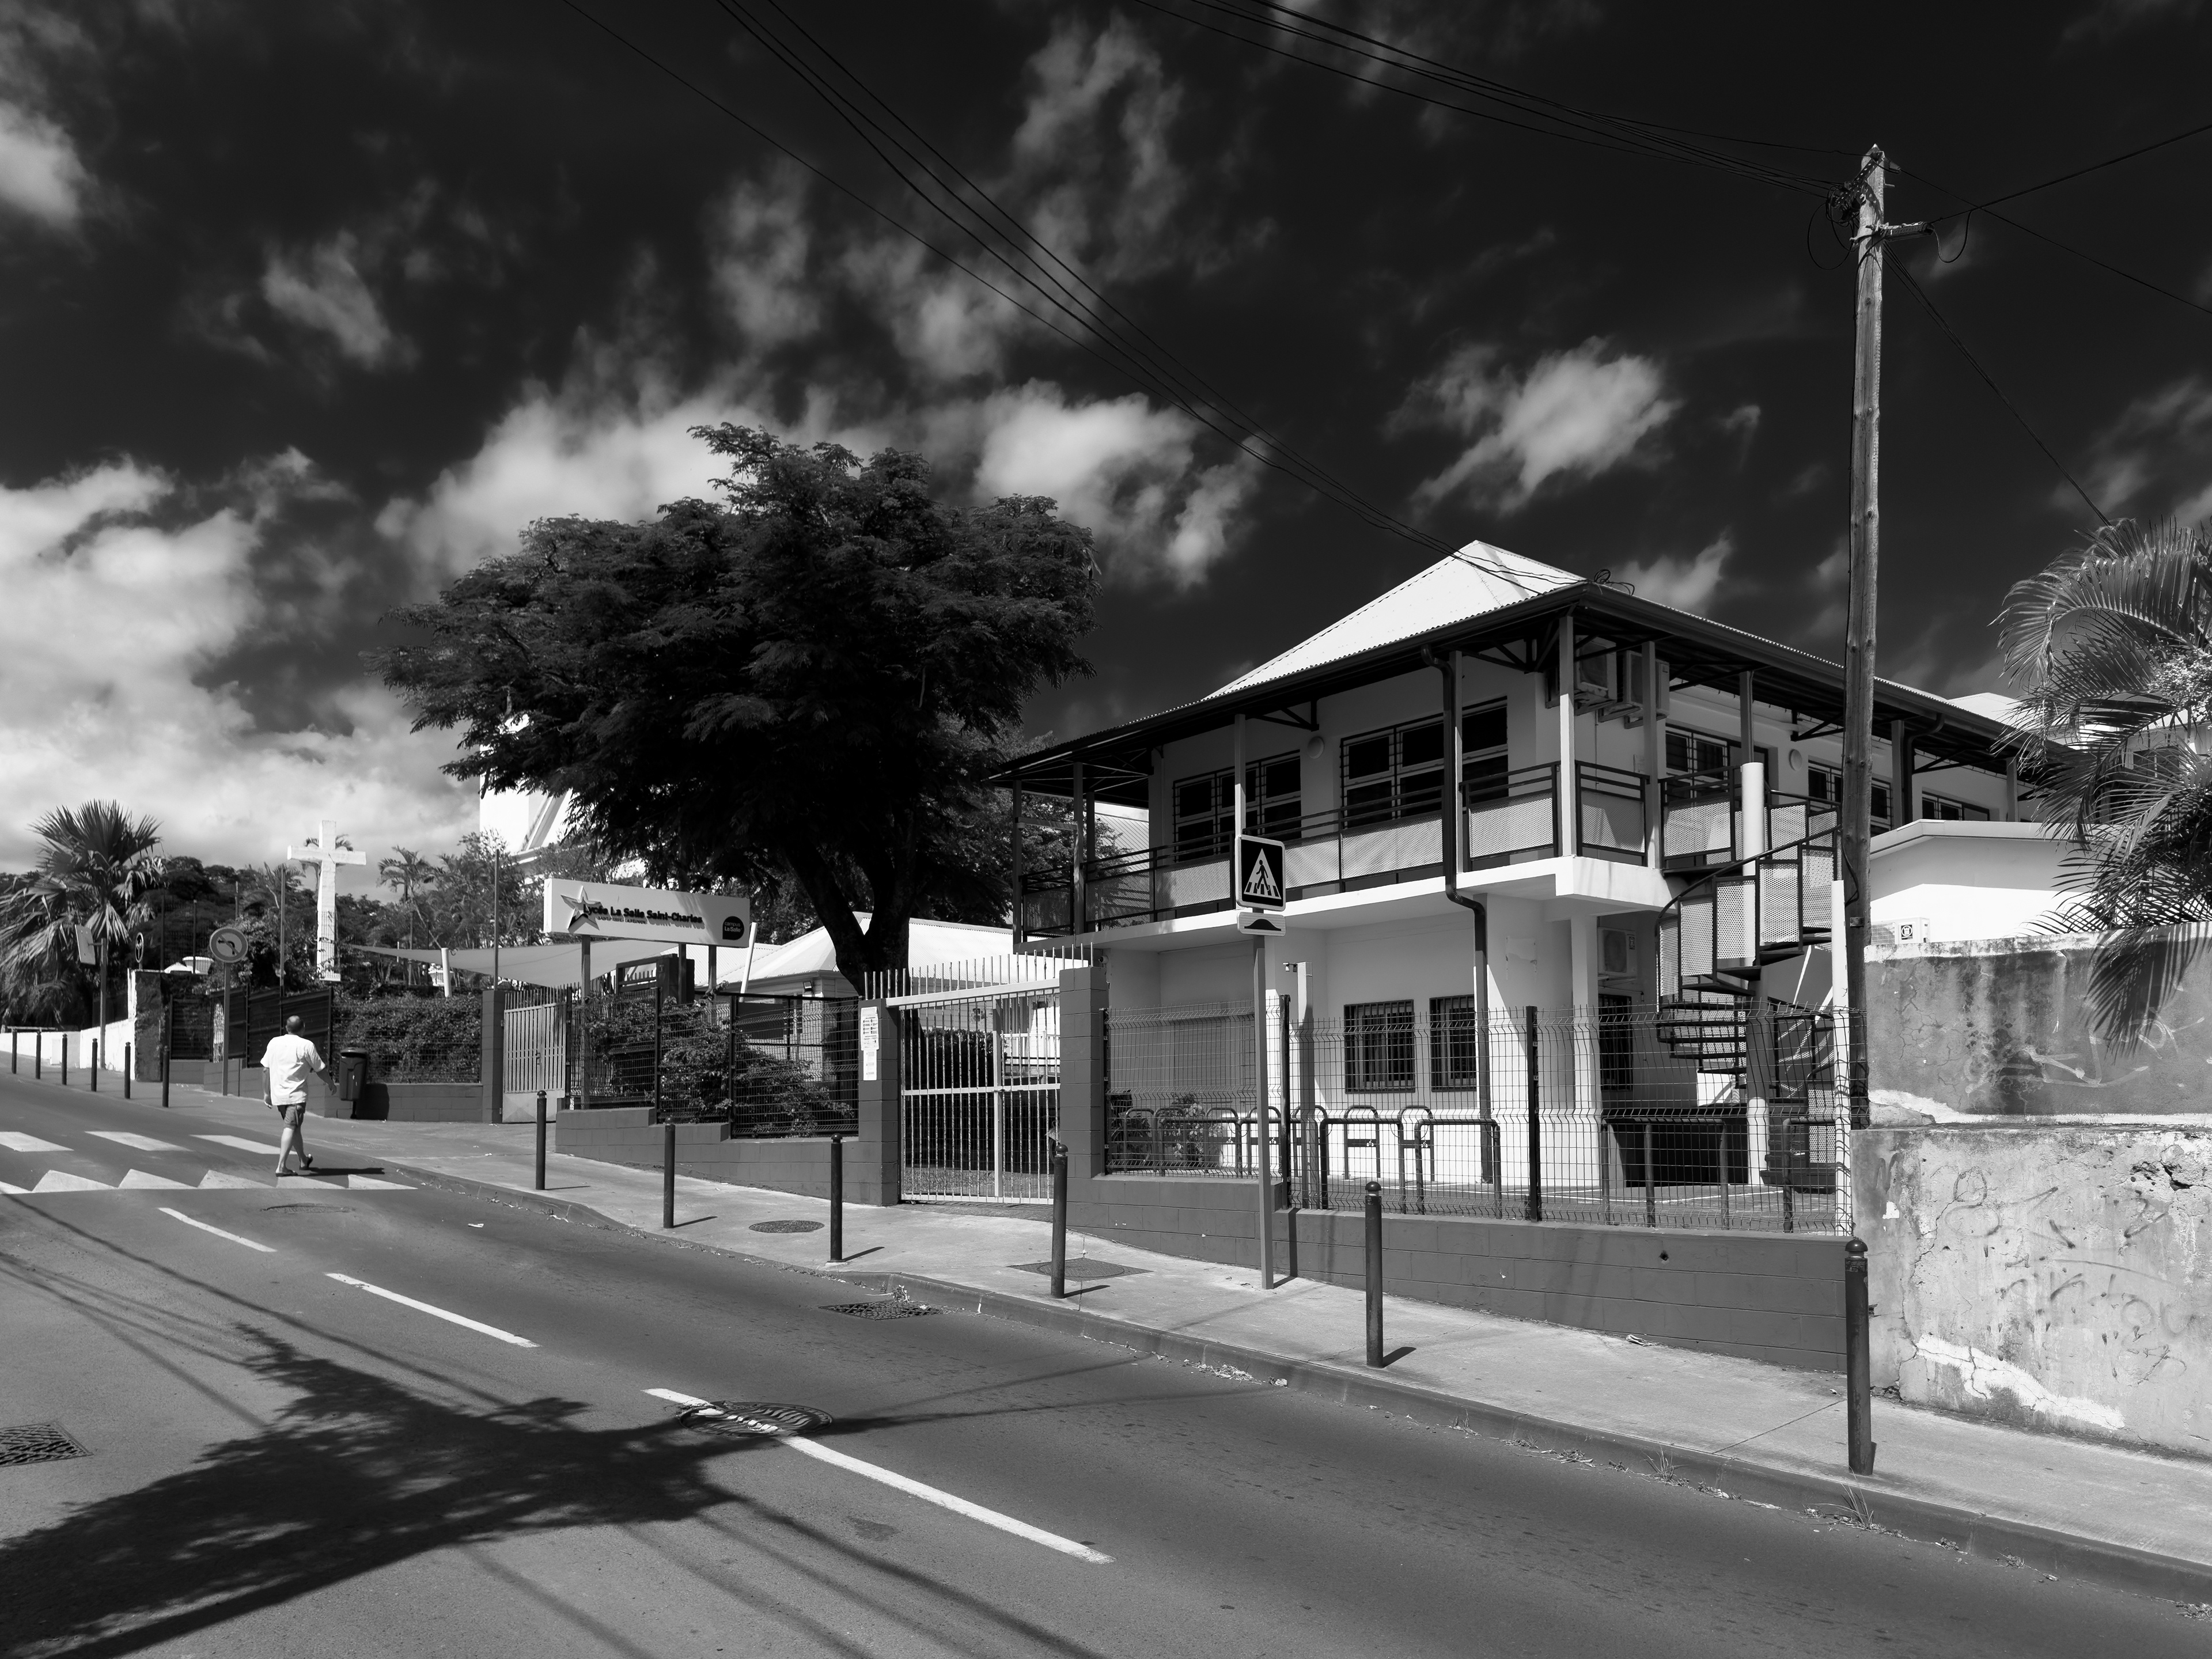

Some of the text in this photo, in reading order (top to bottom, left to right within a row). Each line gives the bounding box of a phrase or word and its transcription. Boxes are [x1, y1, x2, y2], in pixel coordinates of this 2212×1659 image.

[583, 903, 703, 923] Lycée La Salle Saint-Charles
